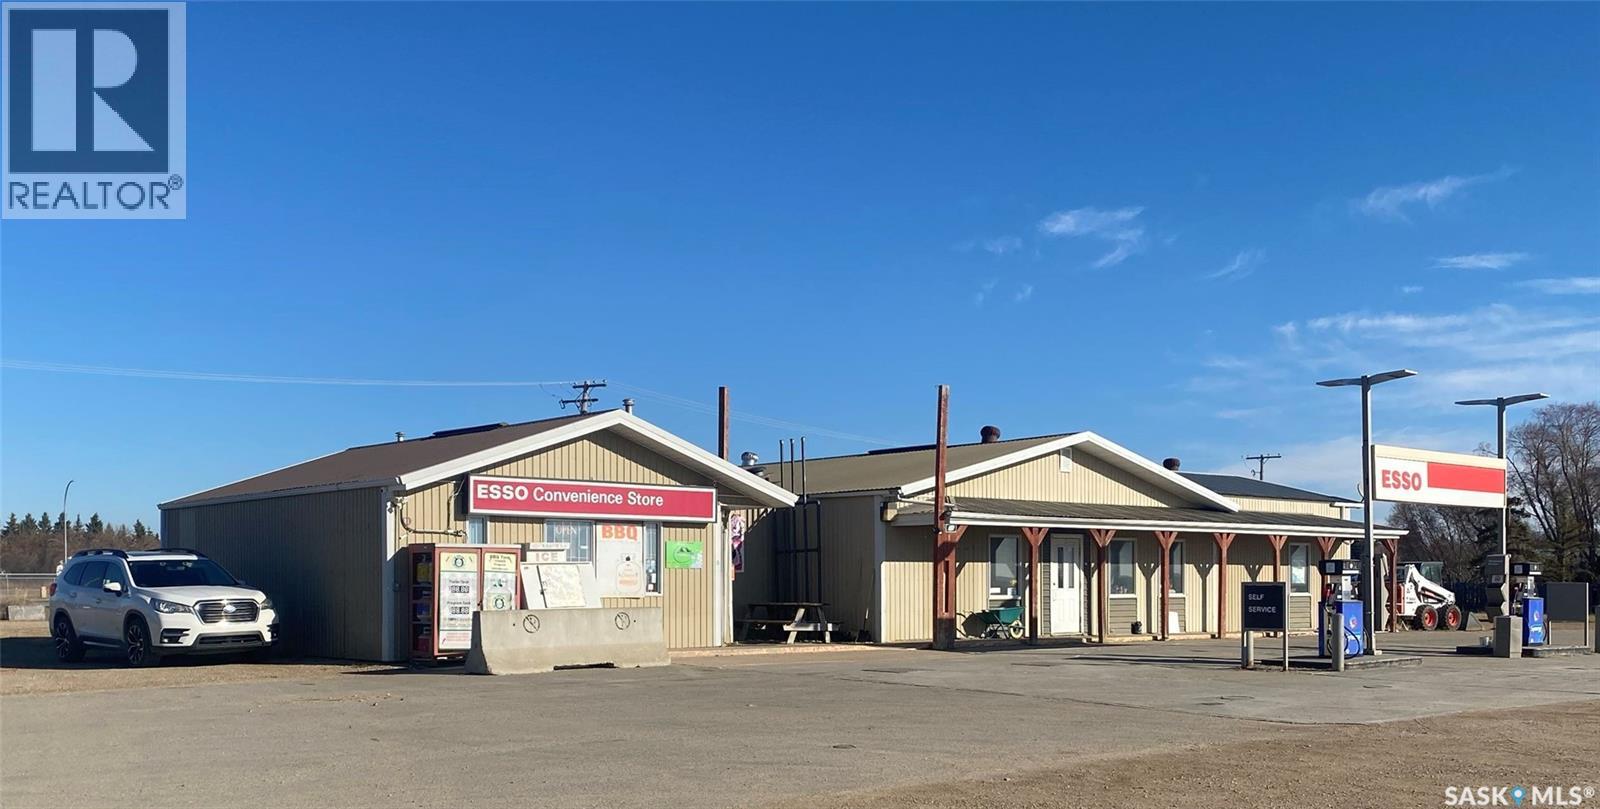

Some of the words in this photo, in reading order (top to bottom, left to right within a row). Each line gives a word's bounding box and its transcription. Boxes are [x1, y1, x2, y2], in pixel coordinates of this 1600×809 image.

[1382, 470, 1422, 491] ESSO
[476, 484, 529, 501] ESSO
[532, 486, 623, 505] Convenience
[626, 490, 664, 507] Store
[555, 525, 577, 535] OPEN
[601, 524, 638, 541] BBQ
[535, 552, 559, 562] ICE
[1248, 593, 1264, 602] SELF
[1248, 606, 1277, 614] SERVICE
